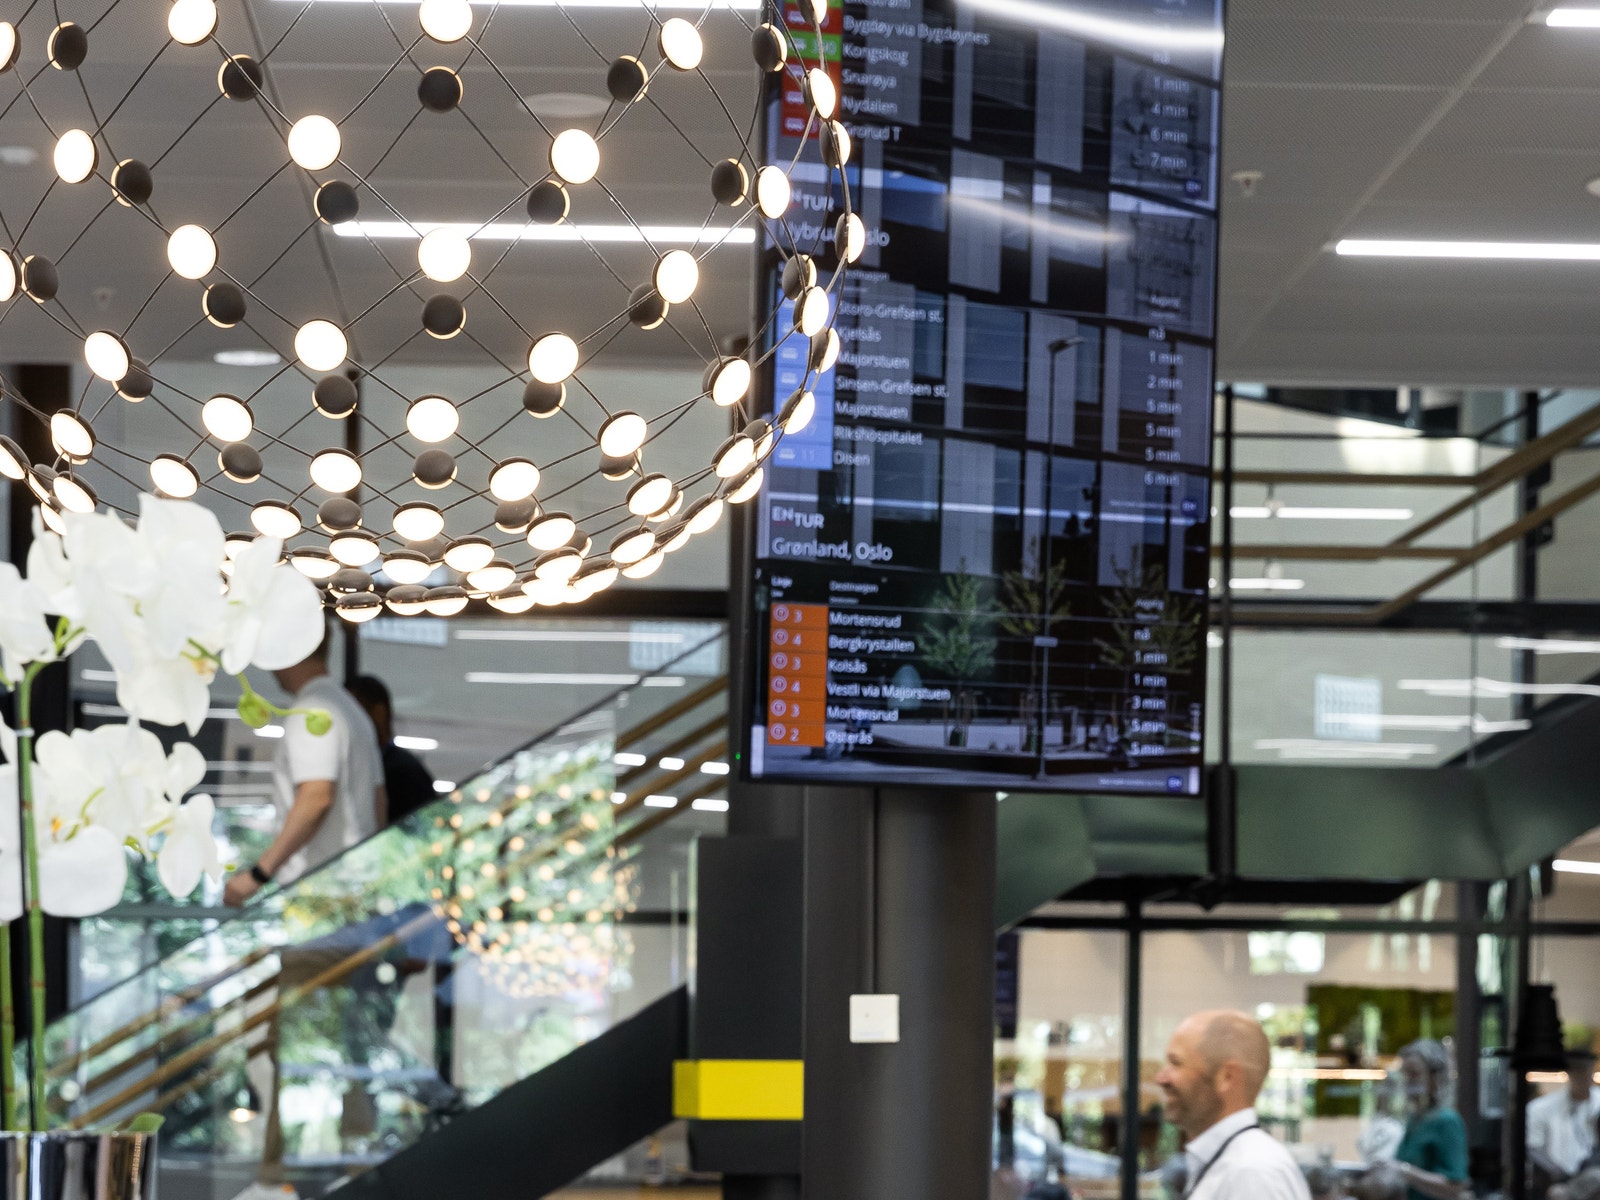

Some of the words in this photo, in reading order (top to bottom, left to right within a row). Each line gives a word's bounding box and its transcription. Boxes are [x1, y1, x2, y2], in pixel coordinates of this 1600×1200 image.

[1158, 353, 1183, 365] min
[1157, 378, 1183, 390] min
[836, 402, 908, 420] Majorstuen
[1156, 401, 1182, 415] min
[1156, 425, 1182, 438] min
[834, 450, 871, 466] Disen
[1155, 449, 1181, 463] min
[1154, 474, 1180, 487] min
[771, 537, 852, 560] Grønland,
[855, 541, 894, 562] Oslo
[829, 611, 902, 629] Mortensrud
[828, 635, 915, 653] Bergkrystallen
[1143, 652, 1167, 665] min
[828, 658, 868, 674] Kolsås
[1142, 675, 1167, 687] min
[827, 683, 860, 697] Vestli
[861, 685, 880, 698] via
[881, 684, 951, 701] Majorstuen
[1142, 697, 1166, 710] min
[827, 705, 899, 722] Mortensrud
[1141, 720, 1166, 733] min
[825, 729, 874, 745] Østerås
[1140, 742, 1165, 756] min
